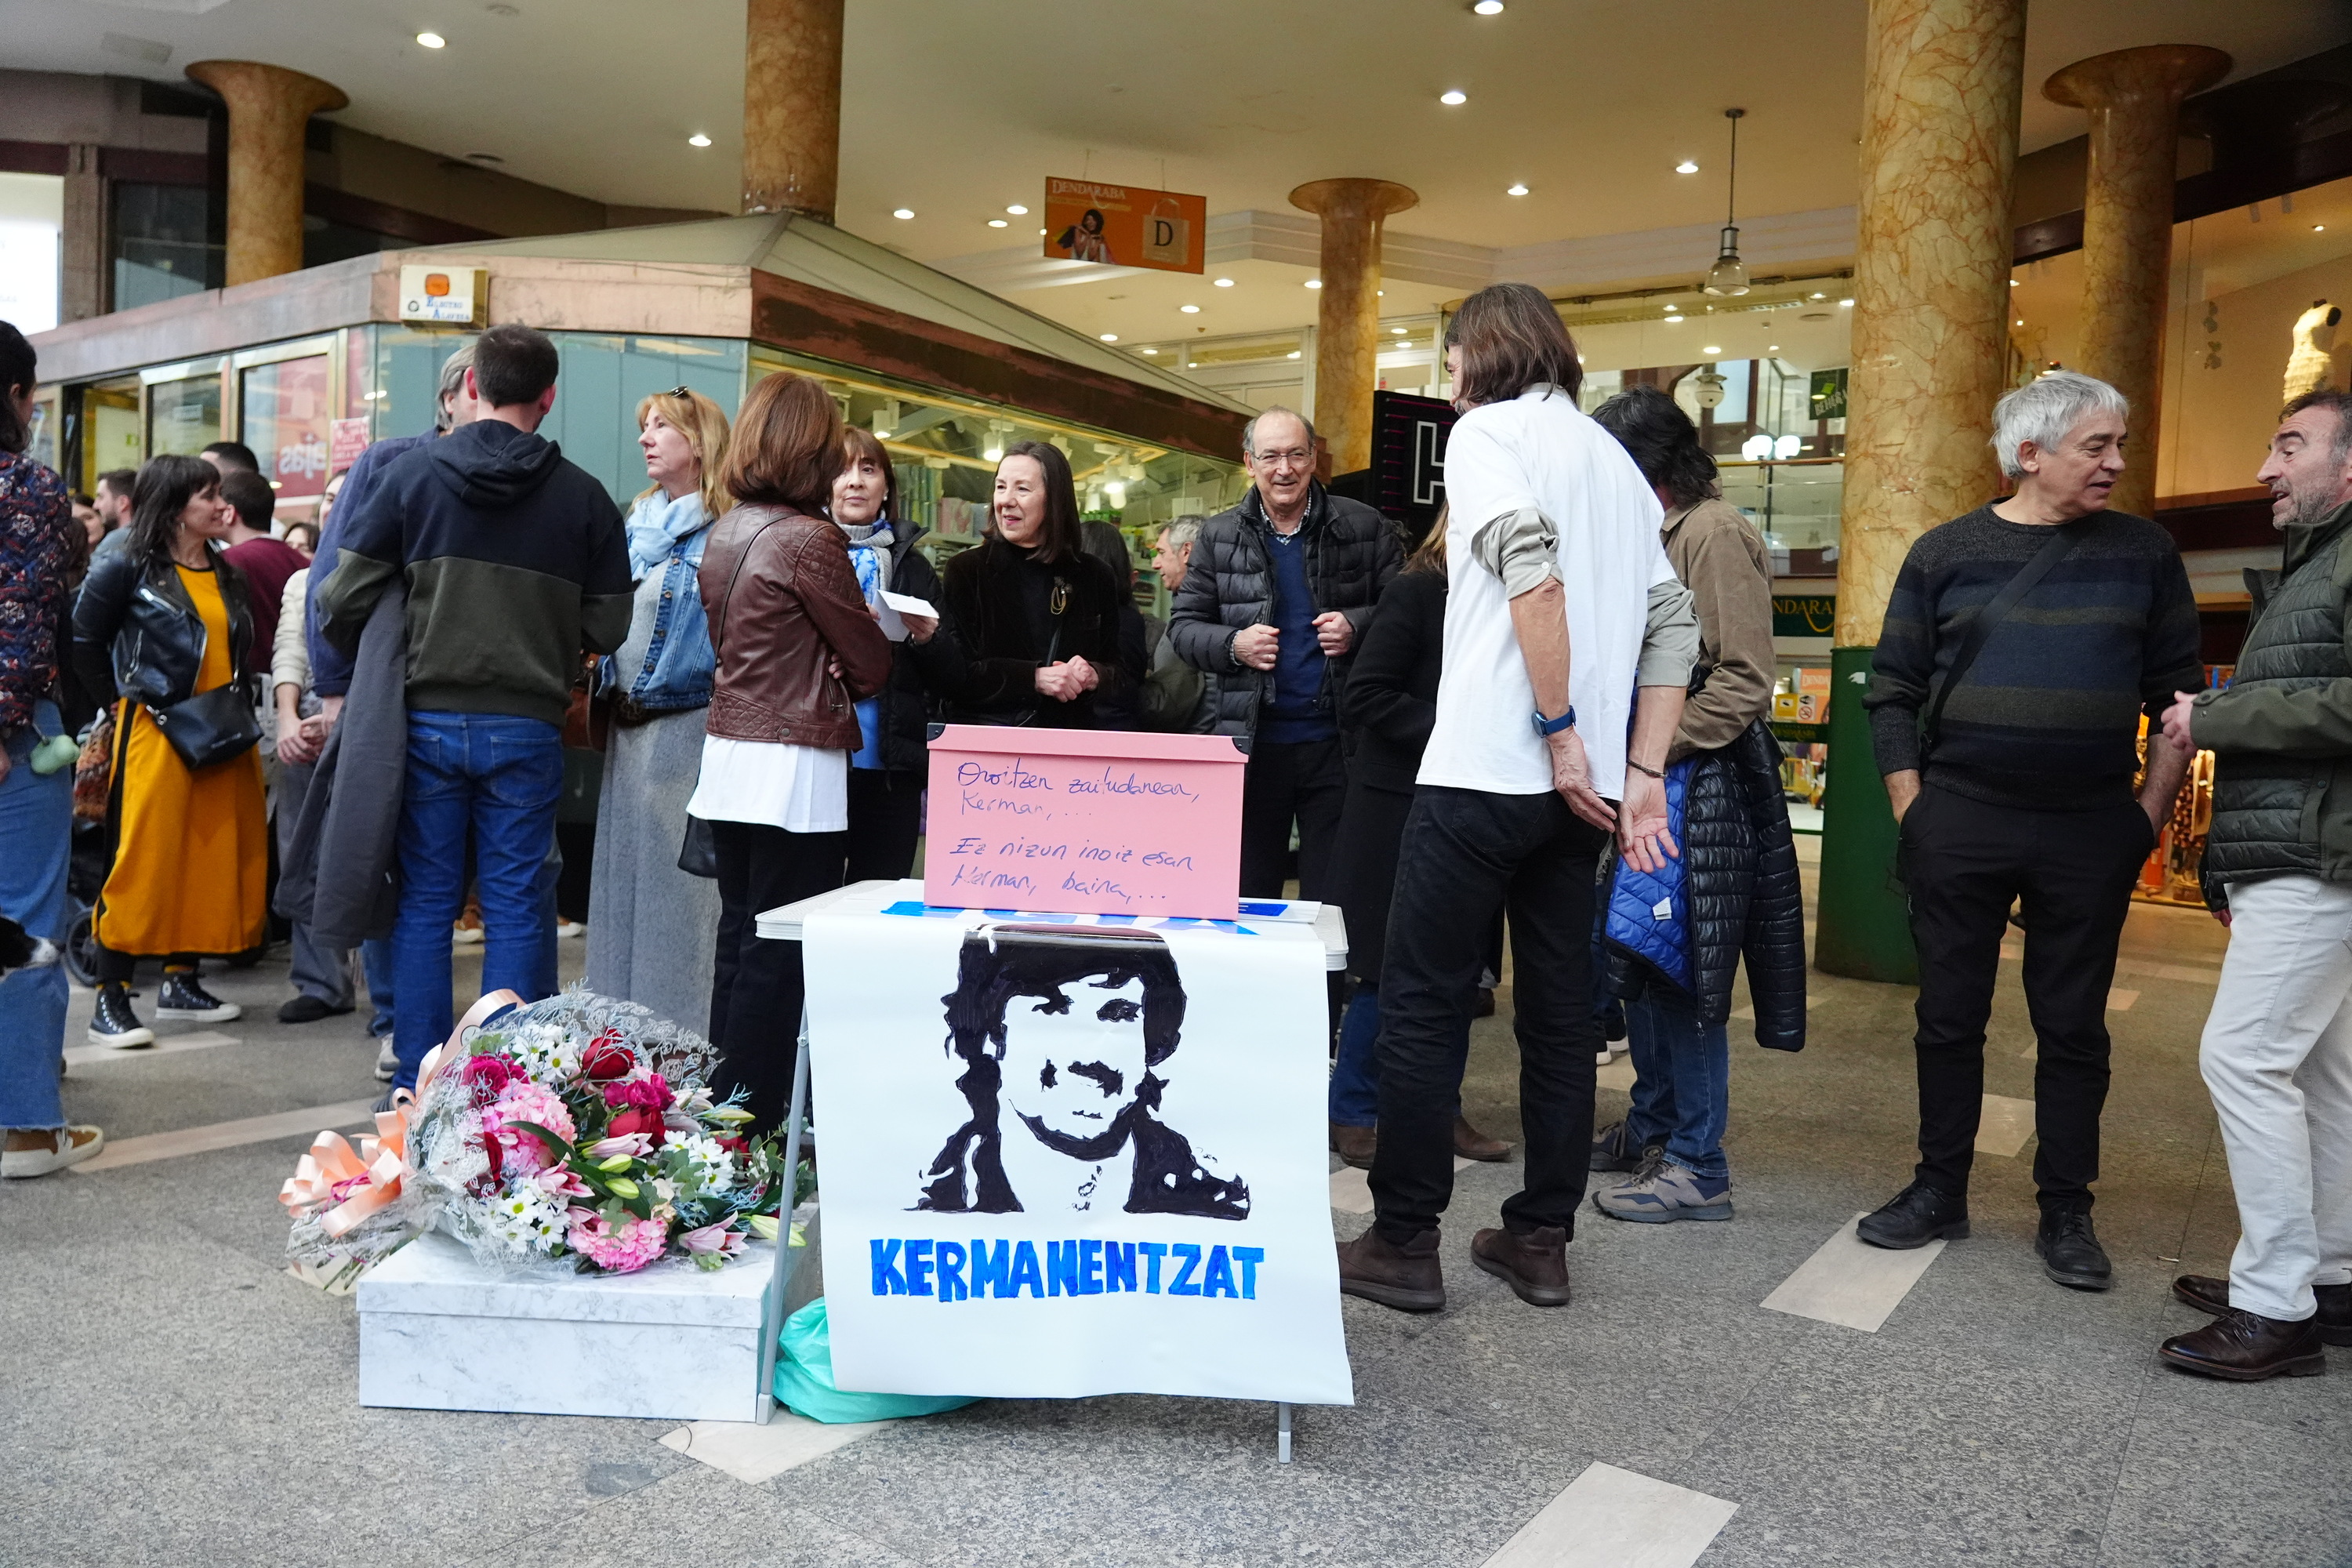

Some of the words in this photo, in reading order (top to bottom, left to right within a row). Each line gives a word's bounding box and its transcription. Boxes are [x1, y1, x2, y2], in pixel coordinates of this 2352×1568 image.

[1052, 180, 1126, 206] DENDARABA
[1154, 220, 1173, 246] D
[958, 757, 1053, 789] Oroitzen
[1000, 837, 1067, 860] nizun
[1142, 851, 1193, 871] esan
[869, 1239, 1265, 1302] KERMANENTZAT
